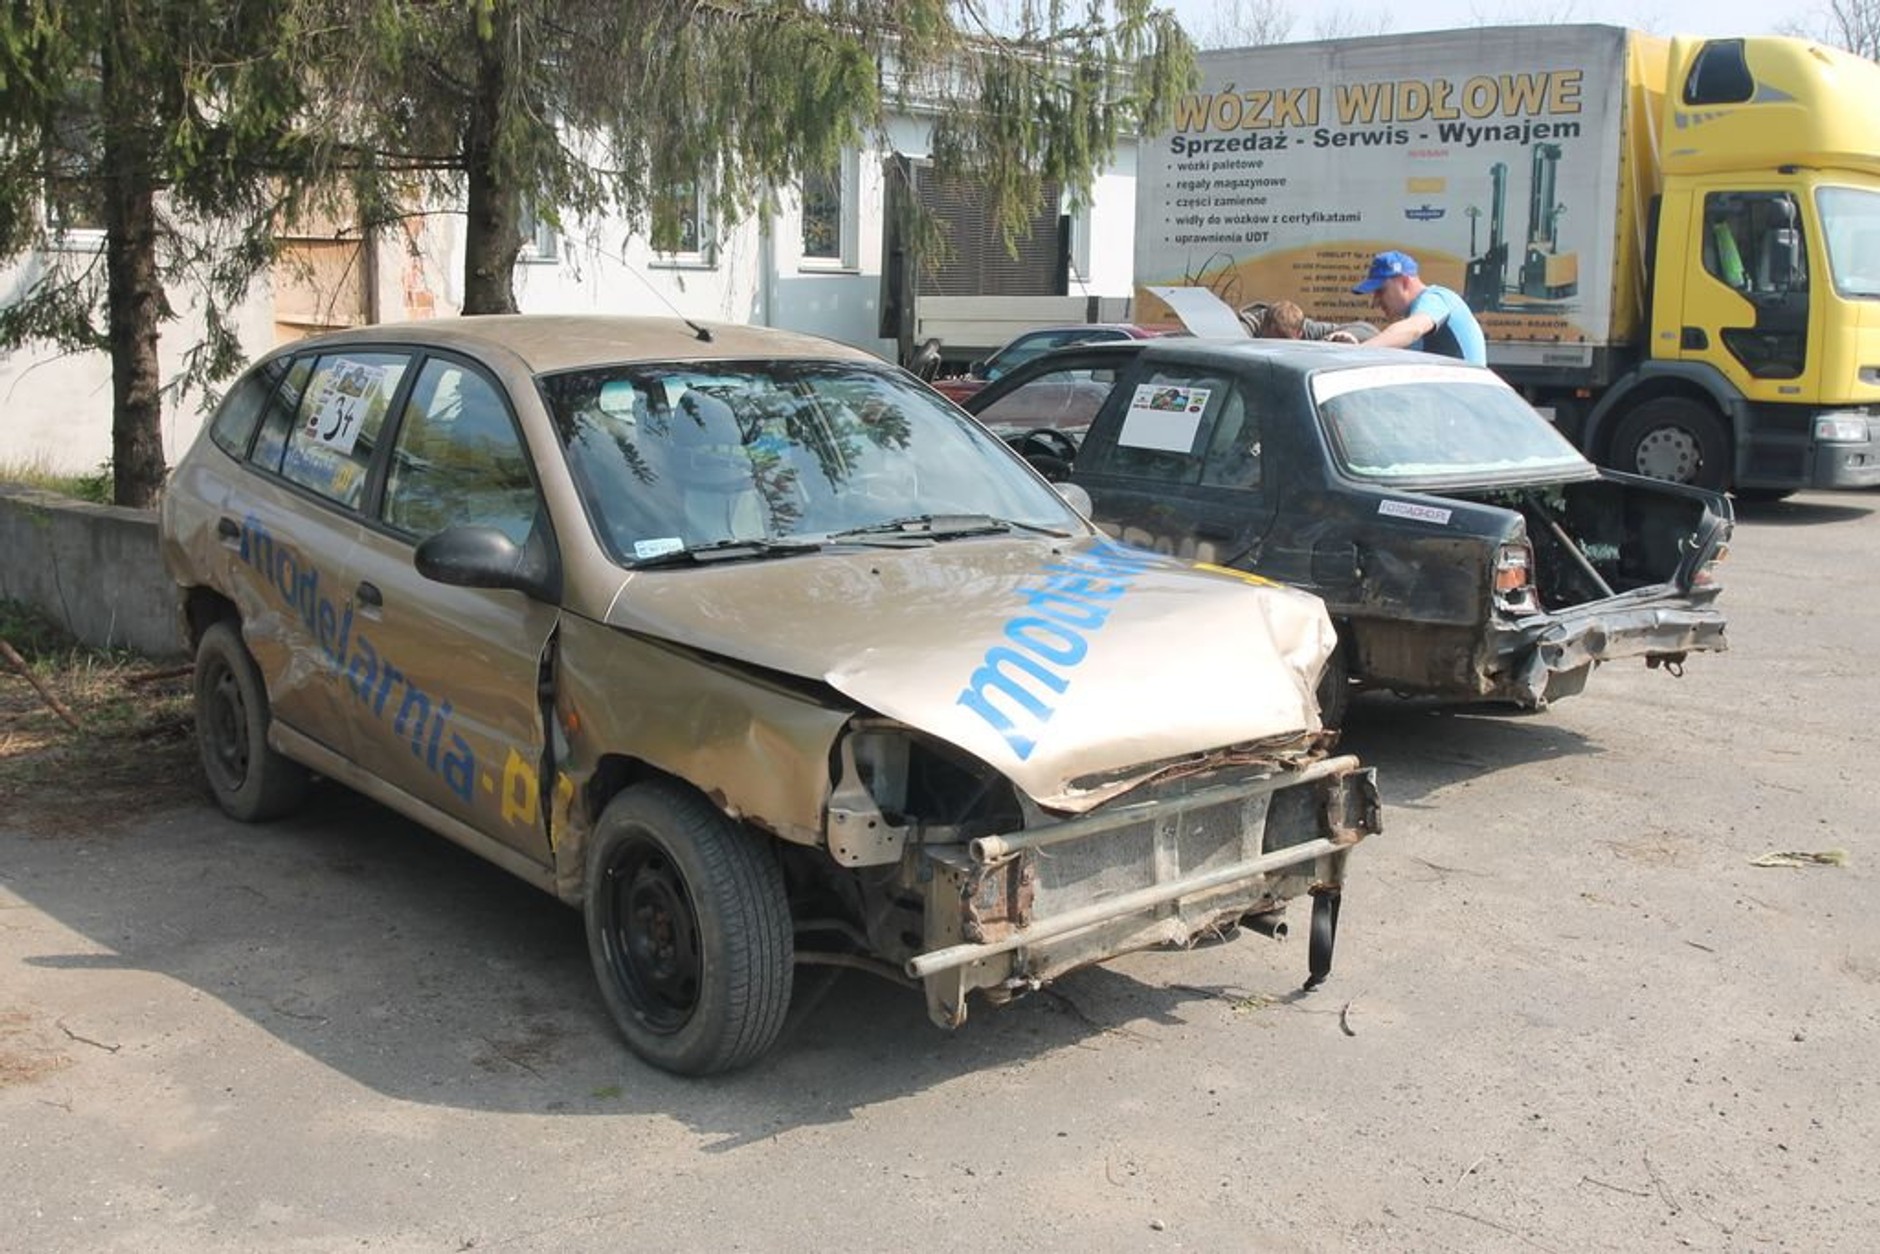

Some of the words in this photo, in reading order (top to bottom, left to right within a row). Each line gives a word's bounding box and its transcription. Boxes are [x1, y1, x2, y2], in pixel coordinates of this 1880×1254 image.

[1173, 82, 1320, 133] WÓZKI
[1335, 69, 1583, 126] WIDŁOWE
[1170, 129, 1288, 157] Sprzedaż
[1313, 125, 1409, 148] Serwis
[1438, 119, 1580, 148] Wynajem
[1212, 158, 1264, 173] paletowe
[1213, 177, 1287, 190] magazynowe
[1213, 195, 1267, 207] zamienne
[1207, 213, 1221, 225] do
[1272, 215, 1279, 224] z
[1281, 211, 1361, 225] certyfikatami
[1175, 232, 1242, 245] uprawnienia
[1245, 231, 1270, 243] UDT
[323, 396, 356, 441] 34
